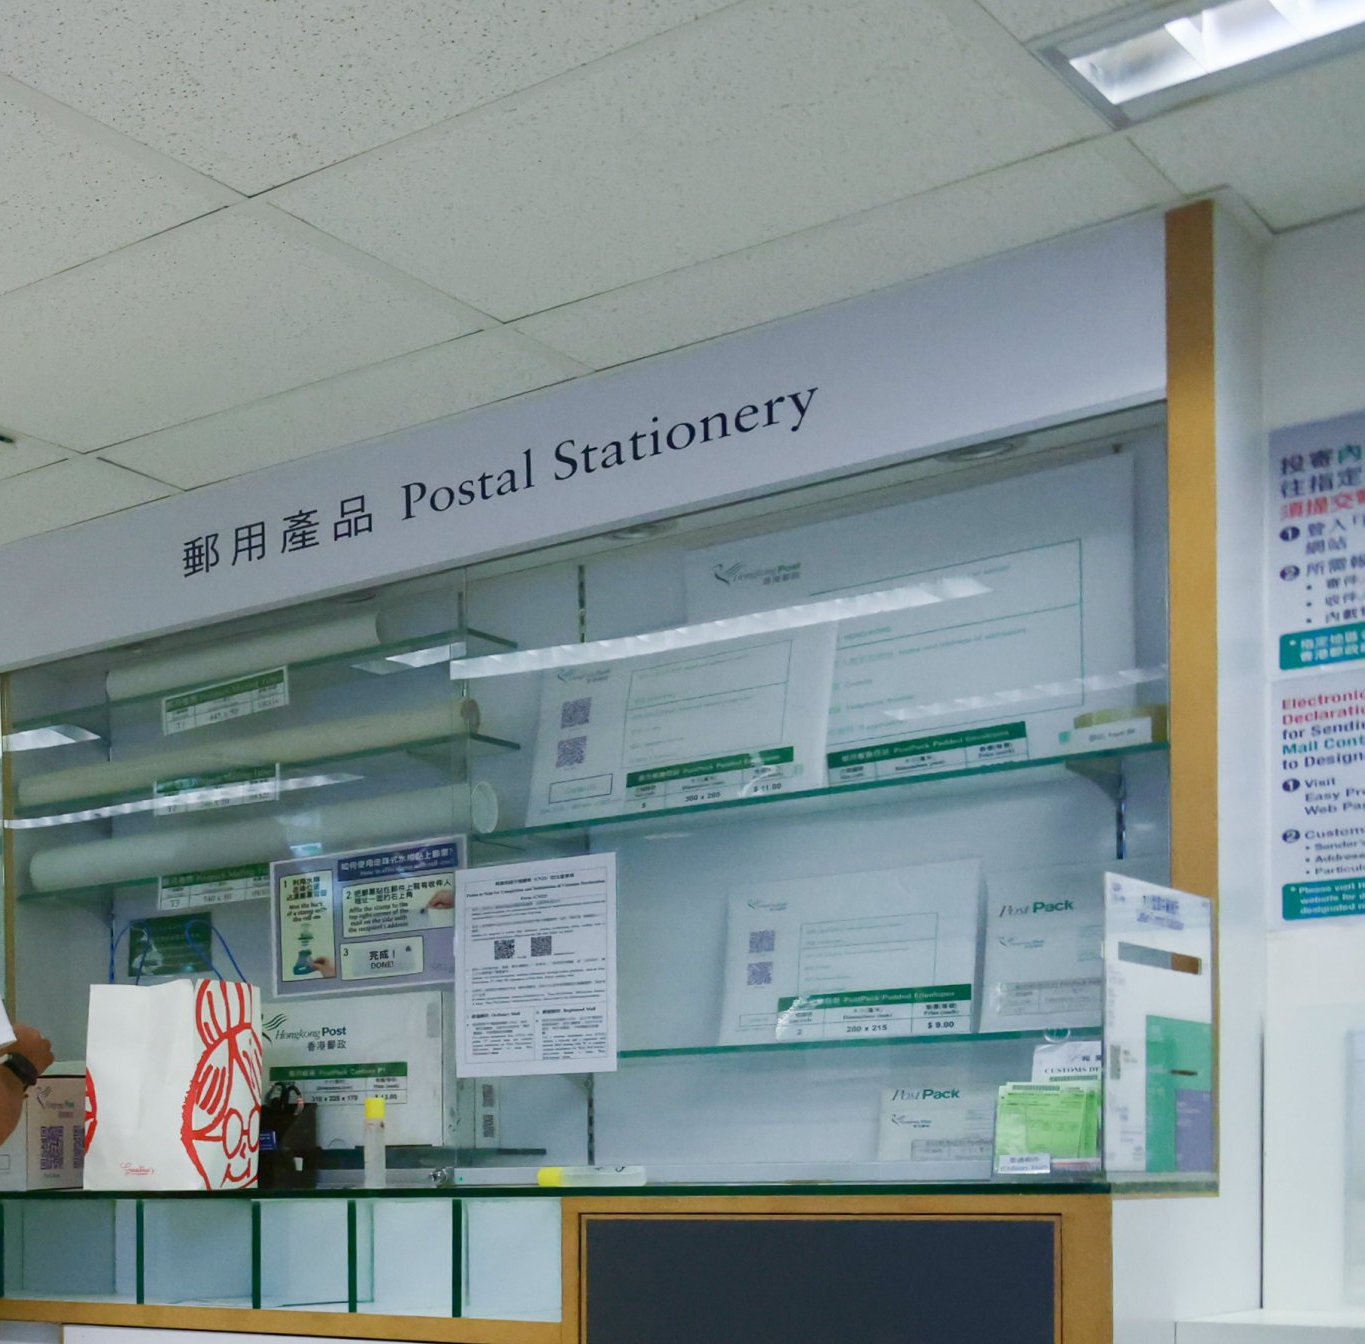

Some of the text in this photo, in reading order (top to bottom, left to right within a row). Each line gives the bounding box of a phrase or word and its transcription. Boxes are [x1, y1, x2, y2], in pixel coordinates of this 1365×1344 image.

[183, 385, 819, 579] 郵用產品 Postal Stationery
[1283, 728, 1306, 740] for
[1282, 740, 1318, 755] Mail
[1282, 759, 1298, 770] to
[1305, 778, 1335, 788] Visit
[1305, 792, 1340, 802] Easy
[1304, 804, 1337, 815] Web
[346, 891, 351, 899] 2
[1033, 899, 1074, 913] Pack
[343, 948, 348, 956] 3
[371, 960, 394, 969] DONE!
[872, 1024, 888, 1032] 215
[927, 1021, 932, 1029] $
[935, 1021, 955, 1029] 9.00
[276, 1026, 347, 1041] Hongkong Post
[307, 1040, 347, 1051] 香港郵政
[922, 1087, 960, 1099] Pack
